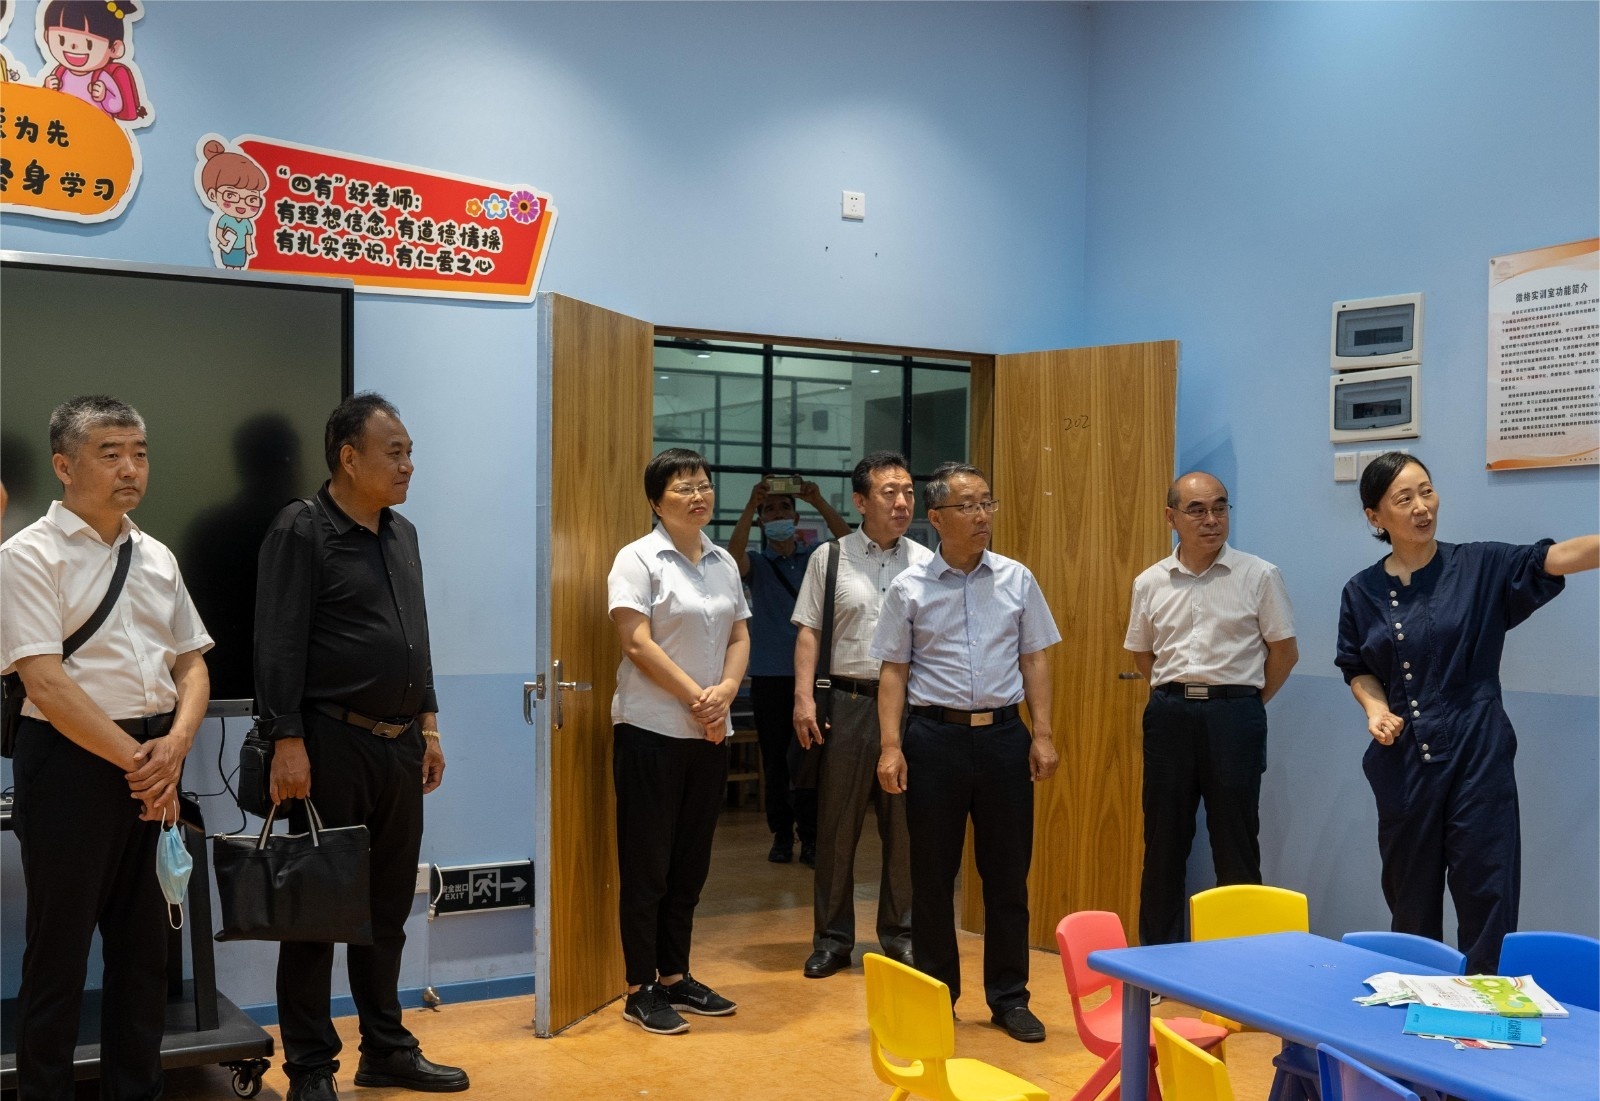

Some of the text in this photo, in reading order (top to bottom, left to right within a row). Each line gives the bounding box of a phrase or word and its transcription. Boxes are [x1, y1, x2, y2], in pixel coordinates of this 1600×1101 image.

[0, 107, 70, 148] 为先
[277, 199, 501, 251] 有理想信念，有道德情操
[276, 229, 493, 273] 有扎实学识，有仁爱之心
[1515, 282, 1588, 303] 微格实训室功能简介
[1063, 414, 1091, 431] 202
[445, 892, 465, 900] EXIT
